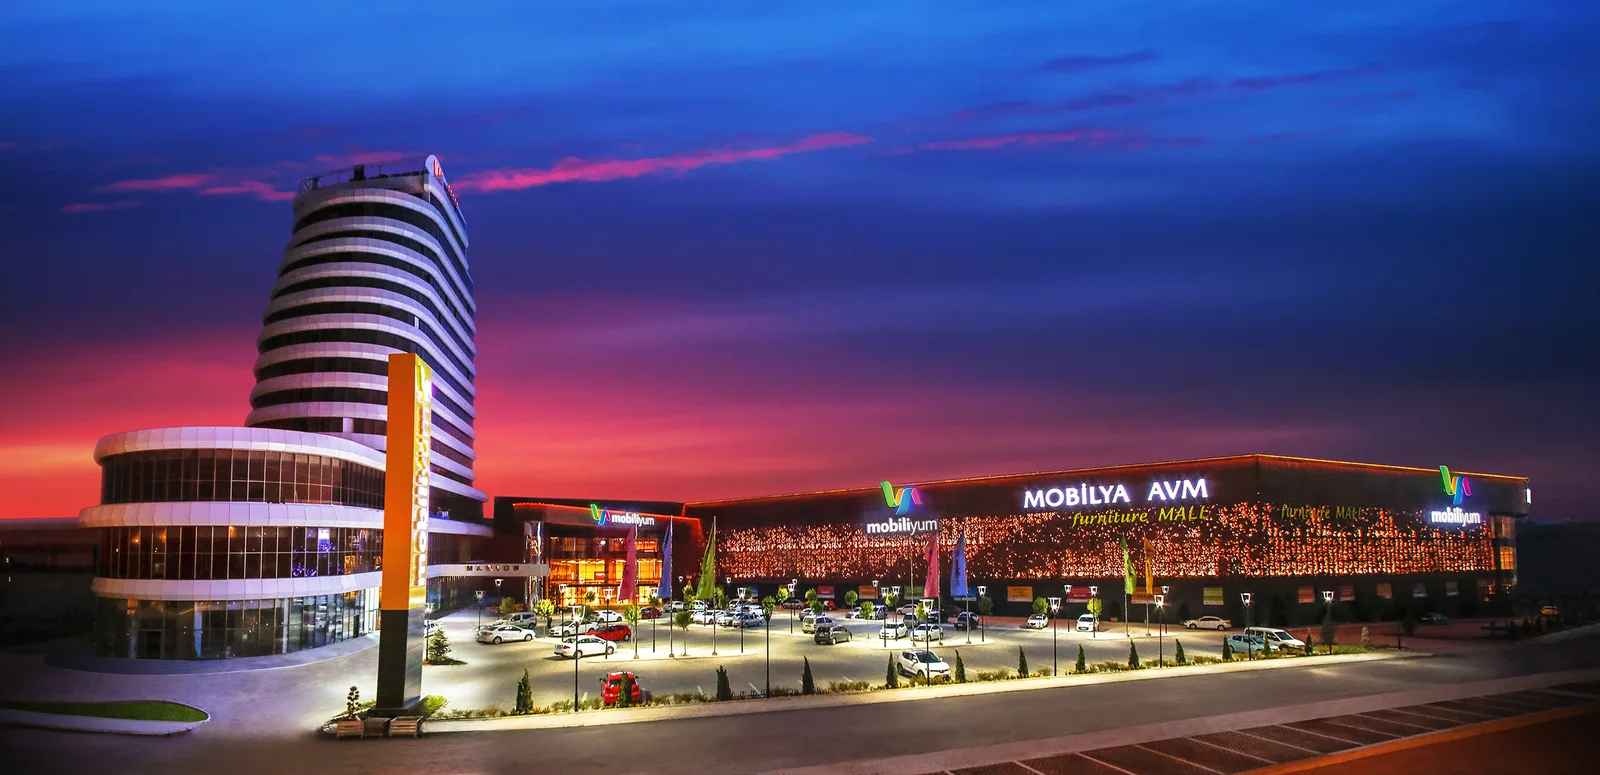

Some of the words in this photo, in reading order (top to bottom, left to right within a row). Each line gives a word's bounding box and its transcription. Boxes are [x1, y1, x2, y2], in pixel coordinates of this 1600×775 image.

[413, 407, 430, 587] mobiliyum
[1023, 483, 1131, 508] MOBİLYA
[1147, 478, 1209, 501] AVM
[611, 512, 655, 527] mobiliyum
[1072, 511, 1148, 528] furniture
[1158, 505, 1208, 521] MALL
[1280, 503, 1330, 520] furniture
[1431, 506, 1481, 527] mobiliyum
[866, 517, 937, 536] mobiliyum
